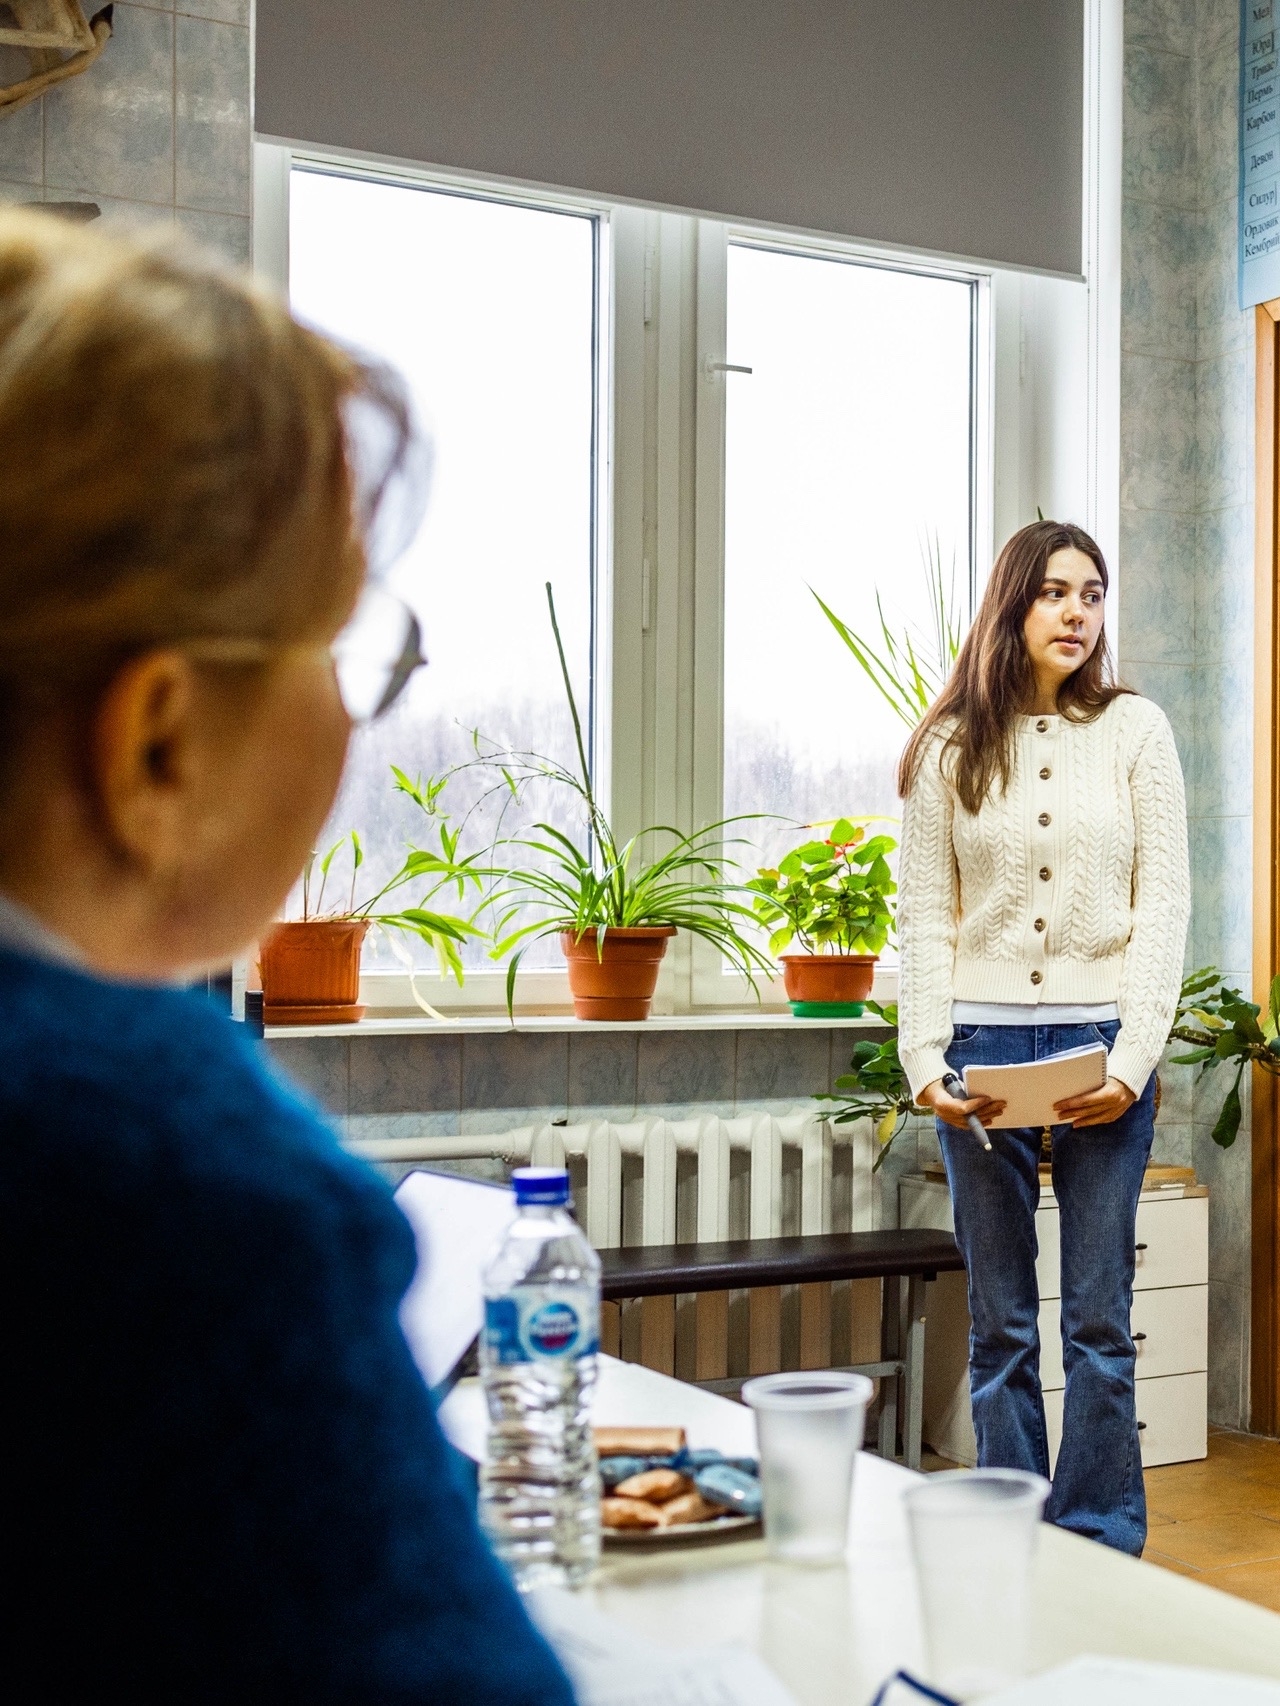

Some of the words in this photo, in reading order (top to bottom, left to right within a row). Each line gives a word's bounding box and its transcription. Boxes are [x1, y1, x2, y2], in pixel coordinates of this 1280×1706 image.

[1247, 85, 1273, 104] Пермь
[1246, 110, 1276, 131] Карбон
[1250, 150, 1274, 171] Девон
[1249, 190, 1275, 207] Силур
[1244, 234, 1280, 257] Кембрий
